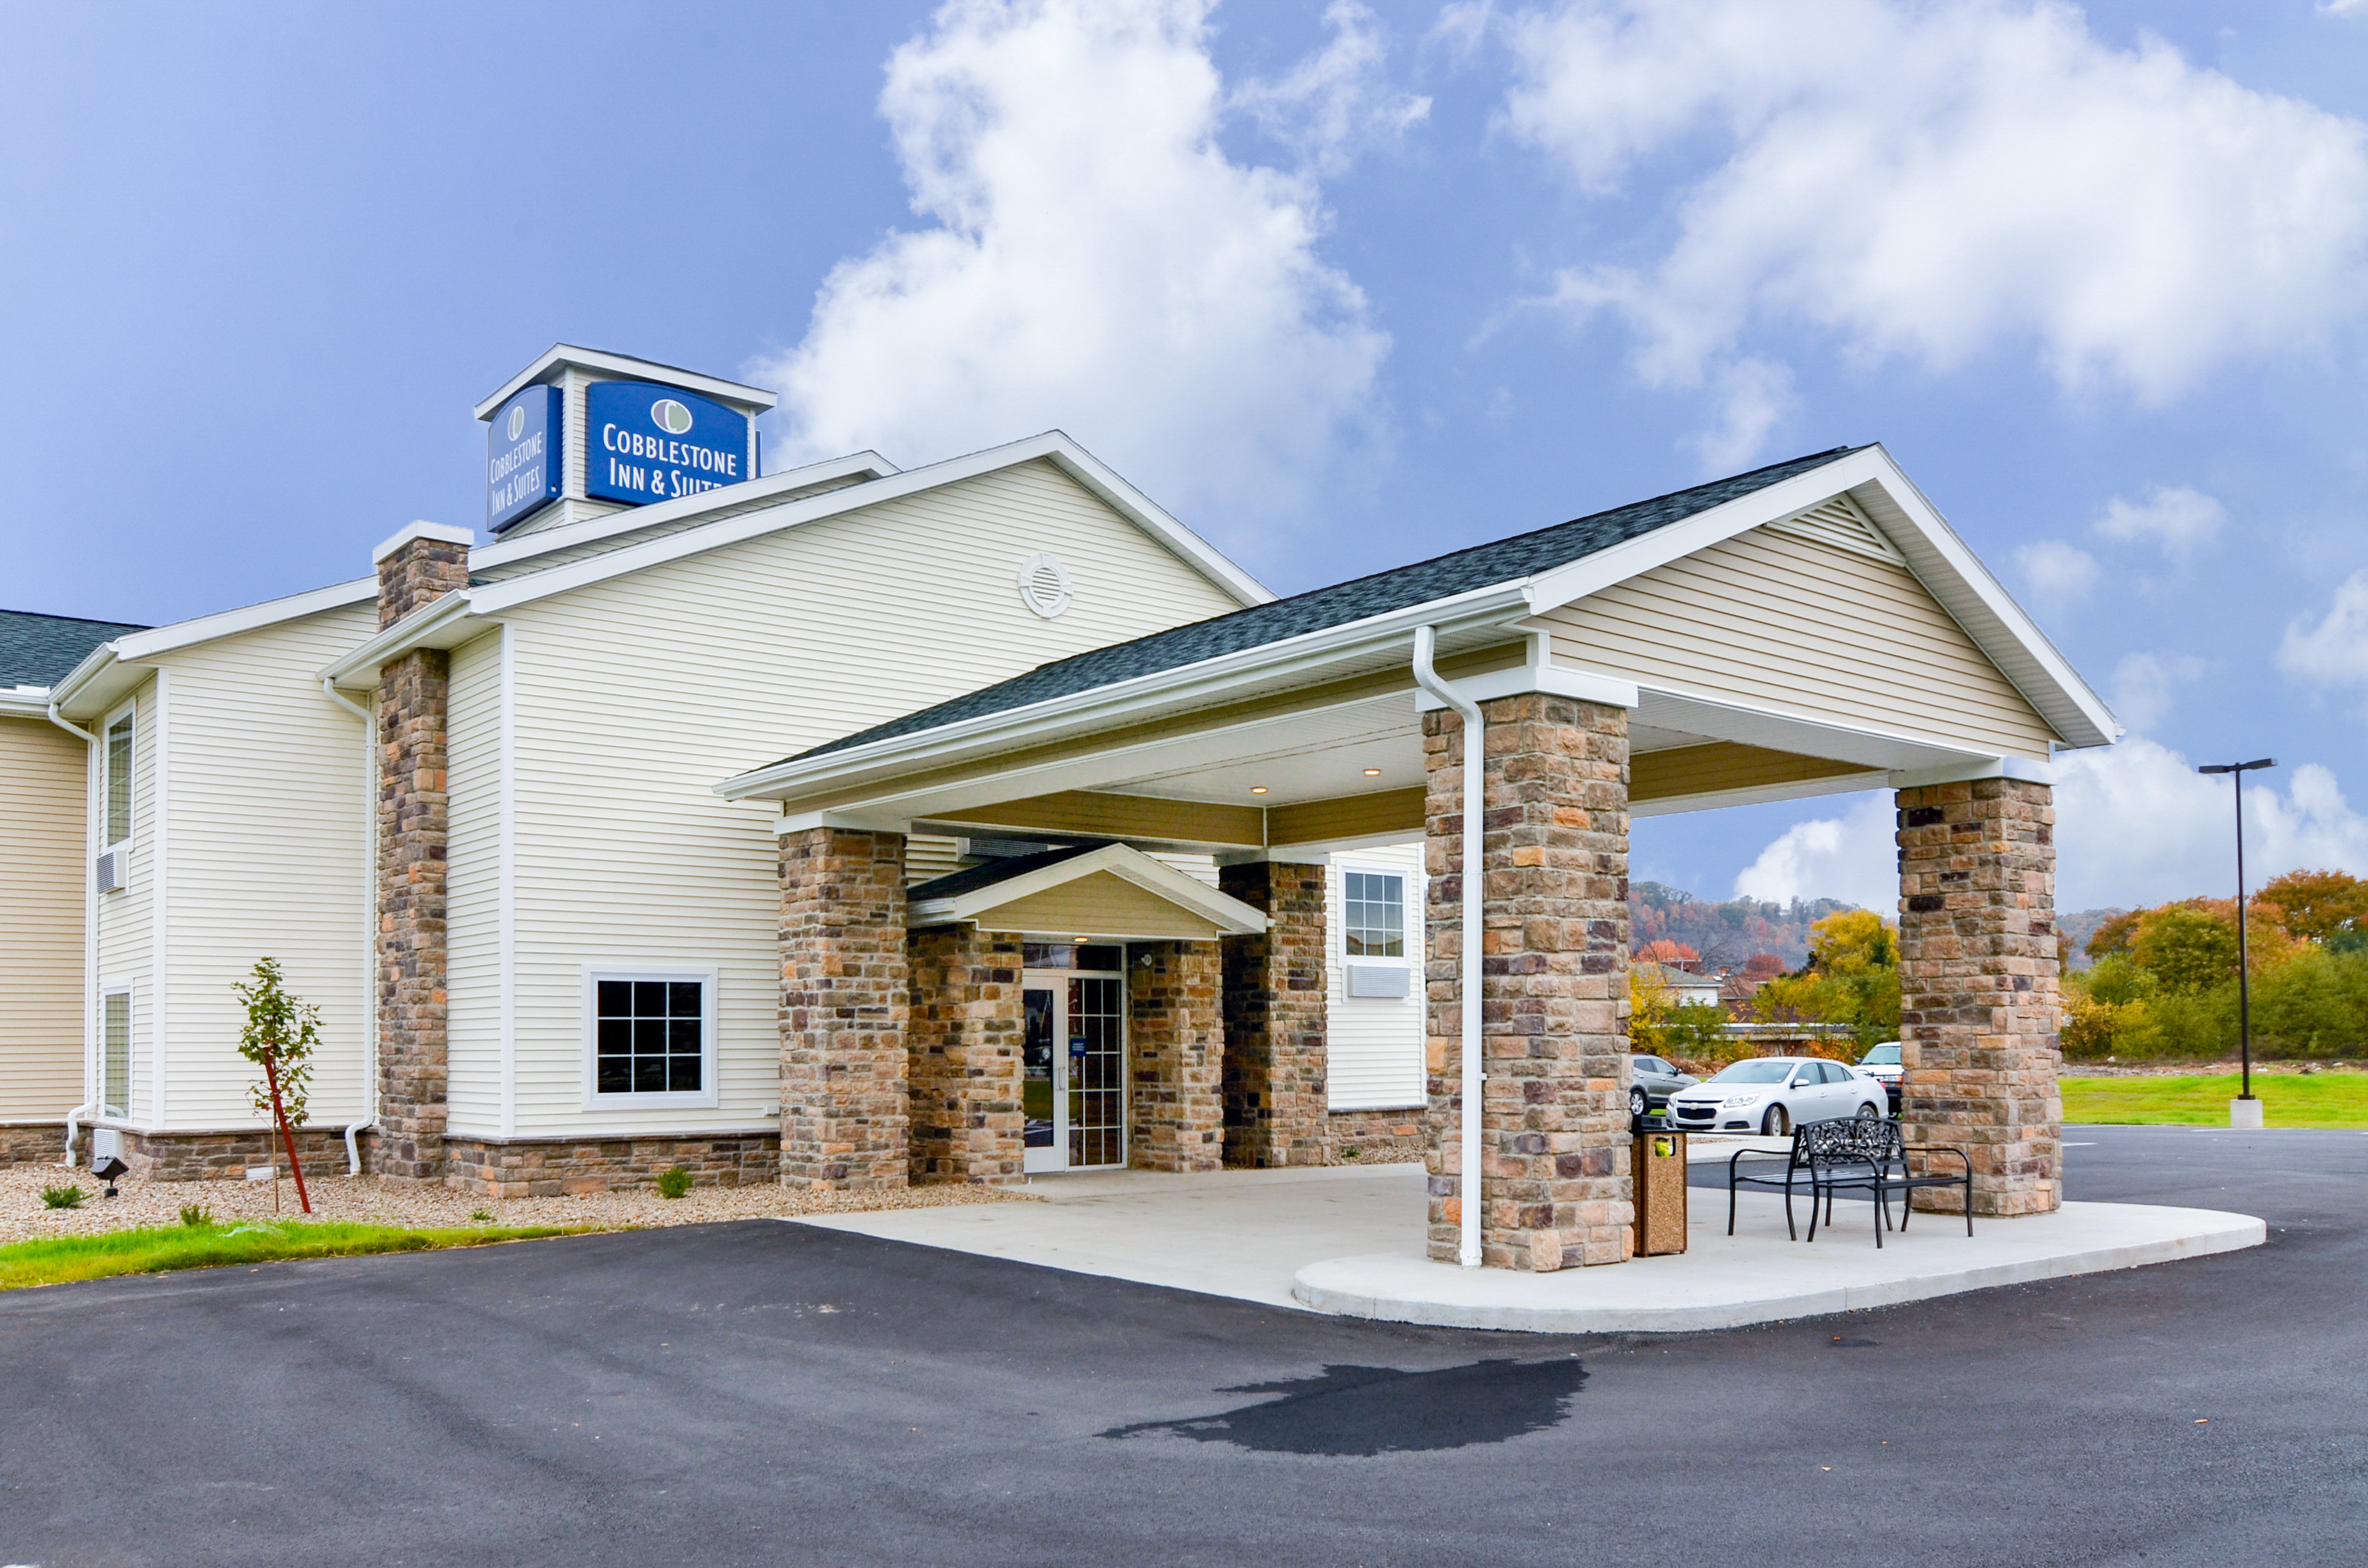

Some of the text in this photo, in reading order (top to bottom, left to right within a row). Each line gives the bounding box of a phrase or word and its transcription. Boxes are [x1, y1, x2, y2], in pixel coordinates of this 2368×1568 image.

[491, 431, 542, 484] COBBLESTONE
[603, 423, 737, 476] COBBLESTONE
[492, 465, 539, 516] INN & SUITES
[610, 457, 645, 491] INN
[651, 470, 665, 495] &
